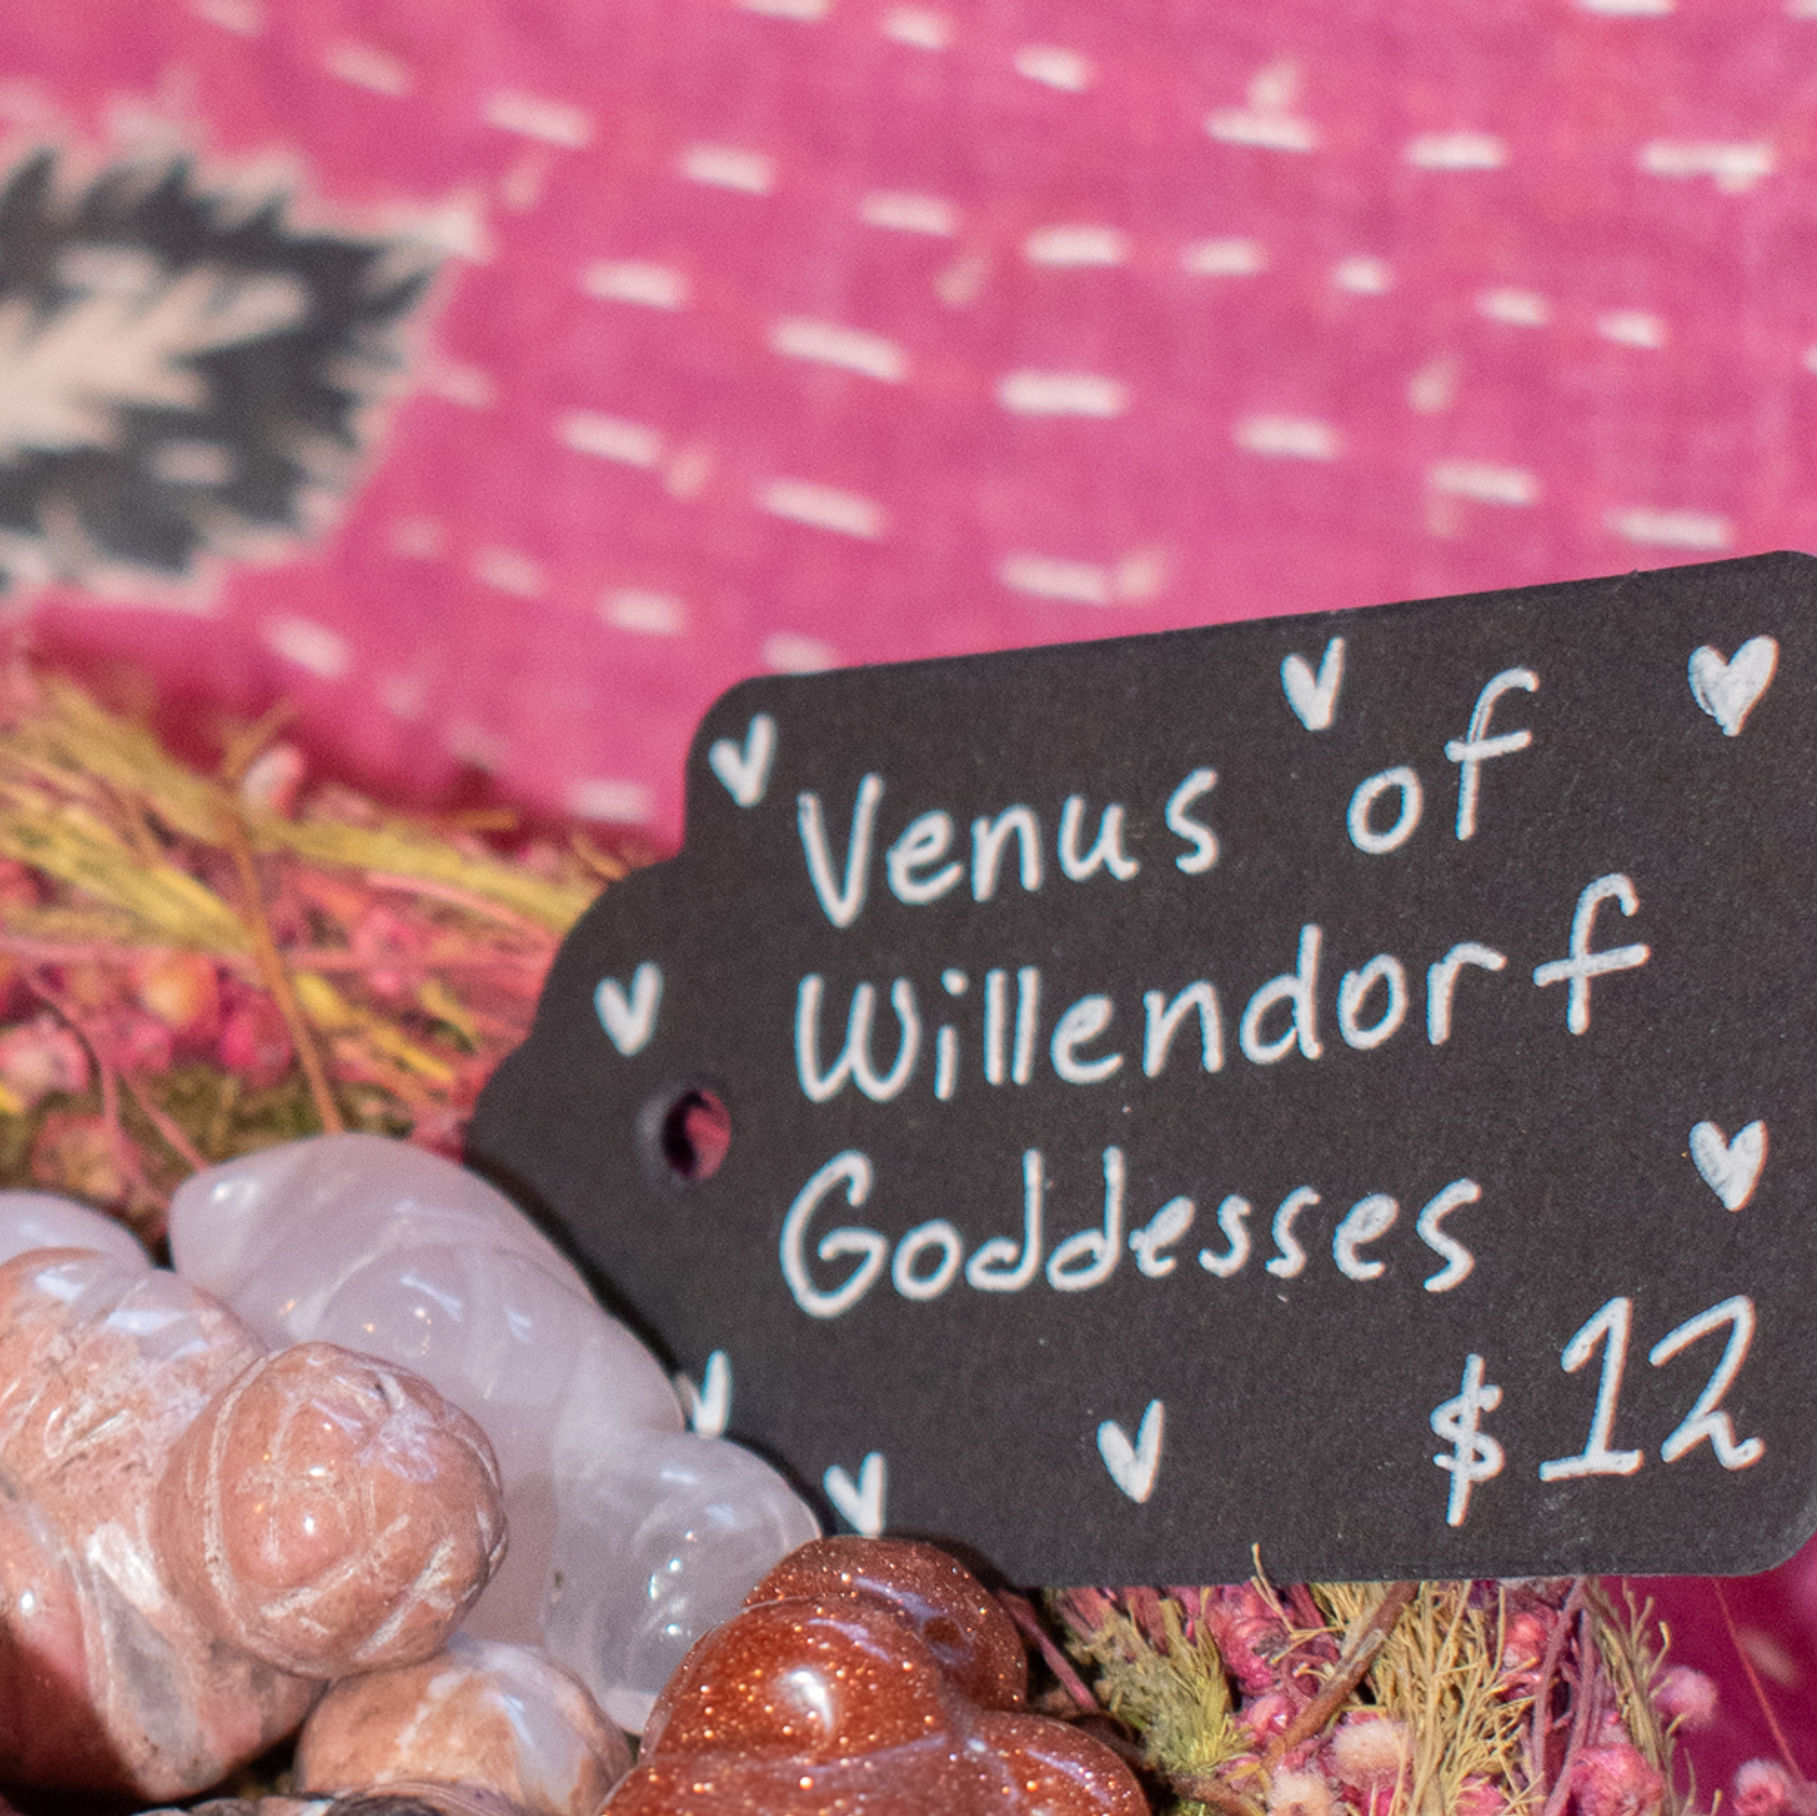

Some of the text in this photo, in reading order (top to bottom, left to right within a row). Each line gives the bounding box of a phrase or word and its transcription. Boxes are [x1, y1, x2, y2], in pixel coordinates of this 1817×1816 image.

[797, 666, 1541, 927] Venus of
[795, 872, 1651, 1102] Willendorf
[779, 1146, 1482, 1318] Goddesses
[1429, 1295, 1765, 1528] $12
